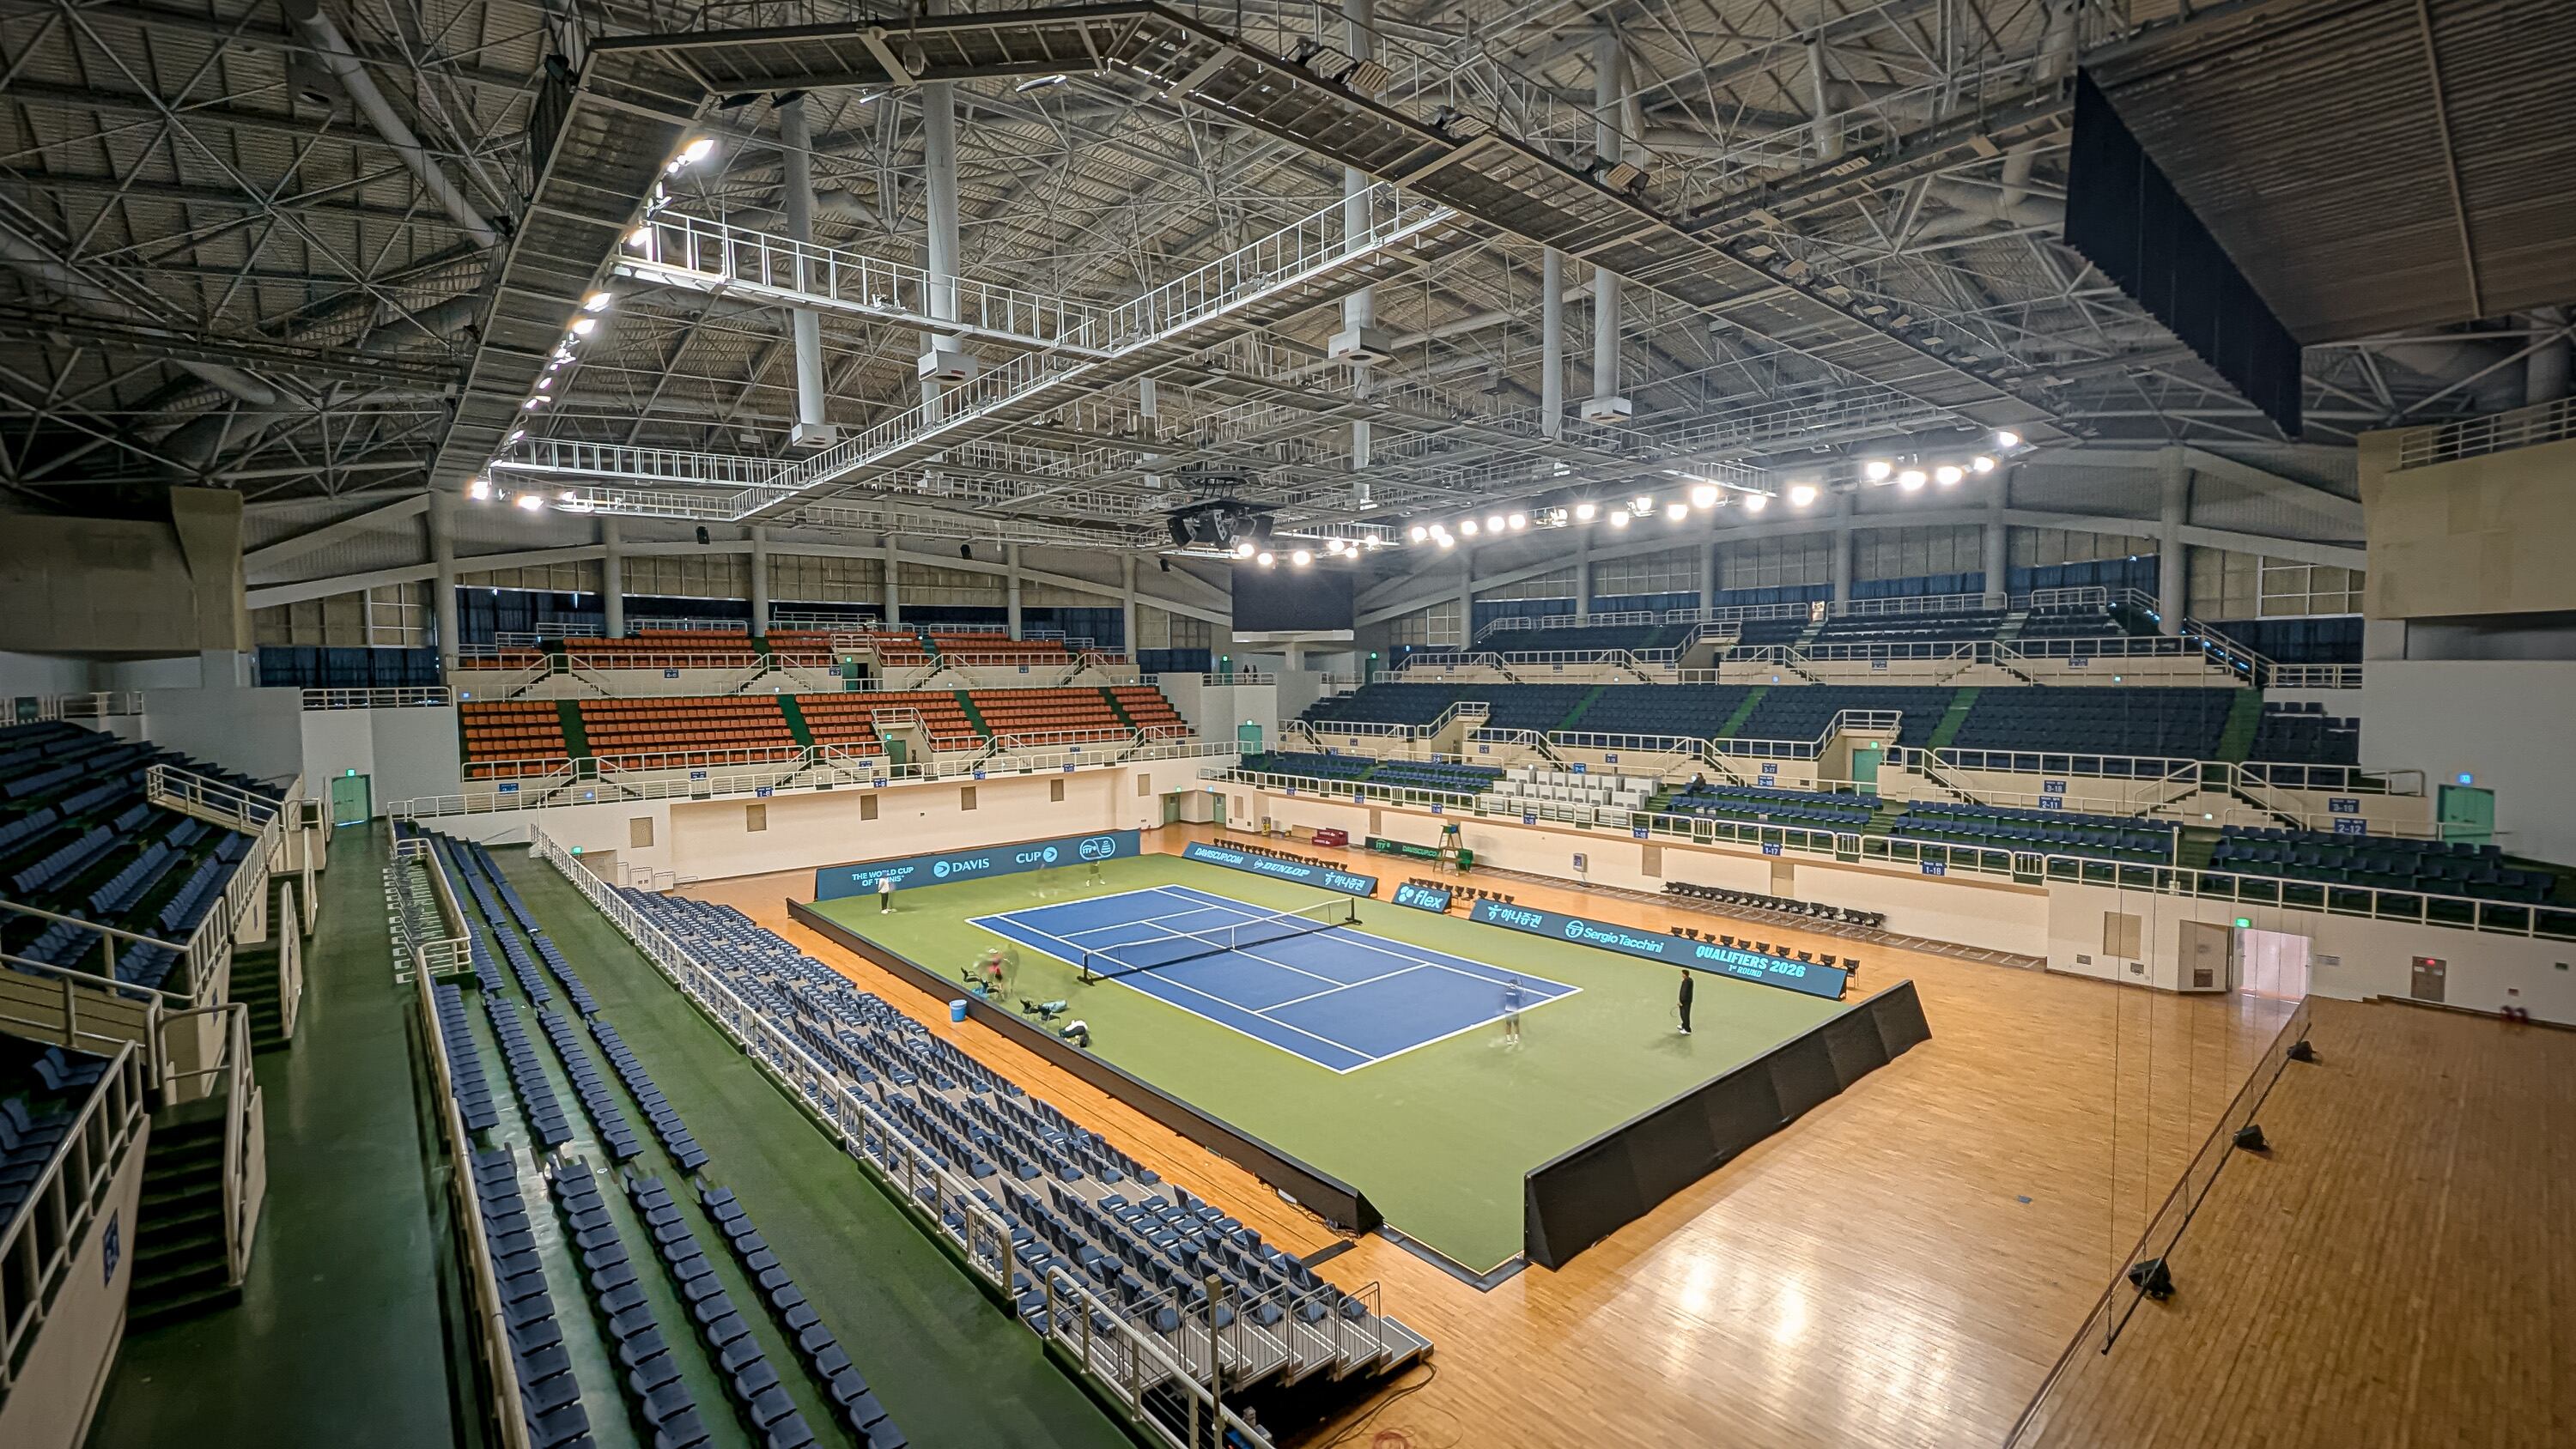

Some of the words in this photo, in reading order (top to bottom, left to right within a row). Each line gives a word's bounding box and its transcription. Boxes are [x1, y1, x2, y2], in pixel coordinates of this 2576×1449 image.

[2042, 800, 2058, 809] 2-11
[2338, 825, 2361, 834] 2-12
[1194, 847, 1243, 864] DAVISCUP.COM
[1402, 846, 1437, 857] DAVISCUP.CO
[952, 858, 990, 872] DAVIS
[1016, 852, 1042, 864] CUP
[1262, 862, 1311, 876] DUNLOP
[852, 872, 868, 881] THE
[897, 866, 914, 875] CUP
[1926, 866, 1941, 875] 1-18
[1334, 875, 1366, 890] 하나증권
[1413, 889, 1443, 908] flex
[1501, 909, 1542, 928] 하나증권
[1583, 927, 1619, 943] Sergio
[1619, 934, 1664, 953] Tacchini
[1696, 945, 1769, 970] QUALIFIERS
[1769, 961, 1806, 978] 2026
[1737, 967, 1763, 978] ROUND
